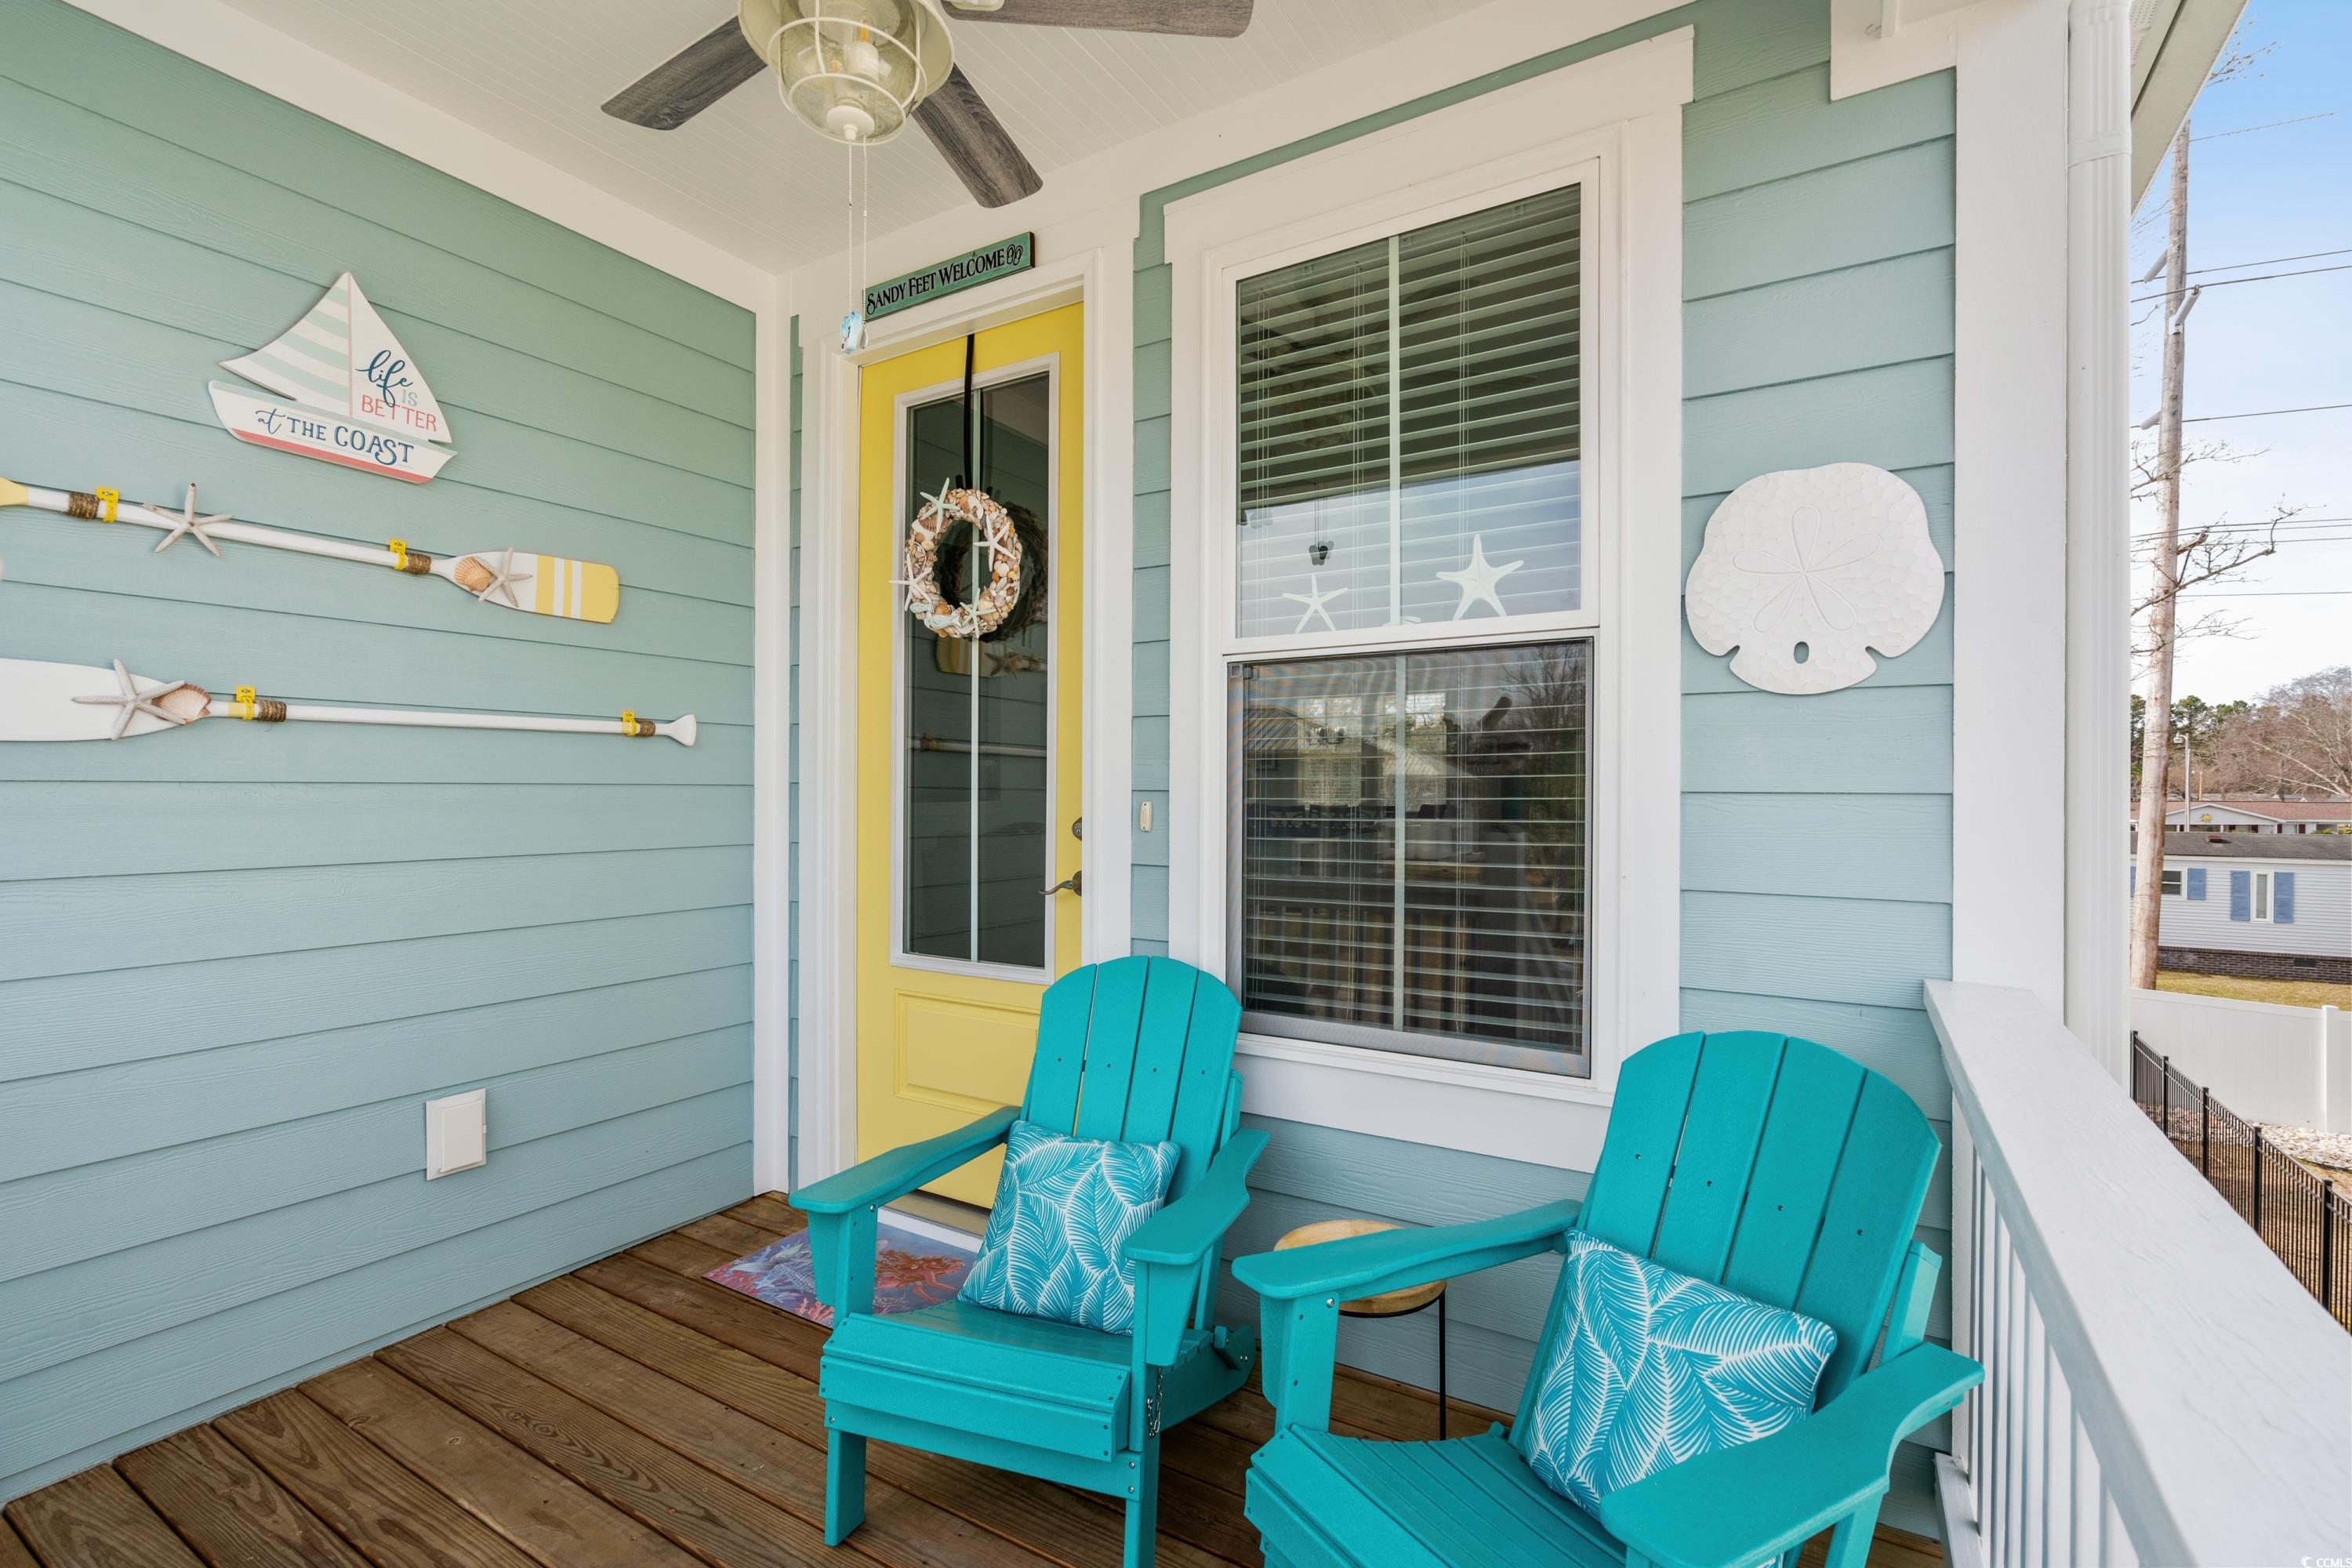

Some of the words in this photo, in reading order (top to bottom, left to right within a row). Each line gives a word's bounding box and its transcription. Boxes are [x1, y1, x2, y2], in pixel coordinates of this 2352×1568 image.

[867, 282, 906, 315] SANDY
[909, 272, 937, 296] FEET
[938, 249, 1004, 286] WELCOME
[355, 350, 413, 408] life
[401, 390, 418, 407] IS
[255, 408, 286, 434] at
[287, 417, 326, 441] THE
[334, 426, 414, 466] COAST
[361, 394, 437, 431] BETTER
